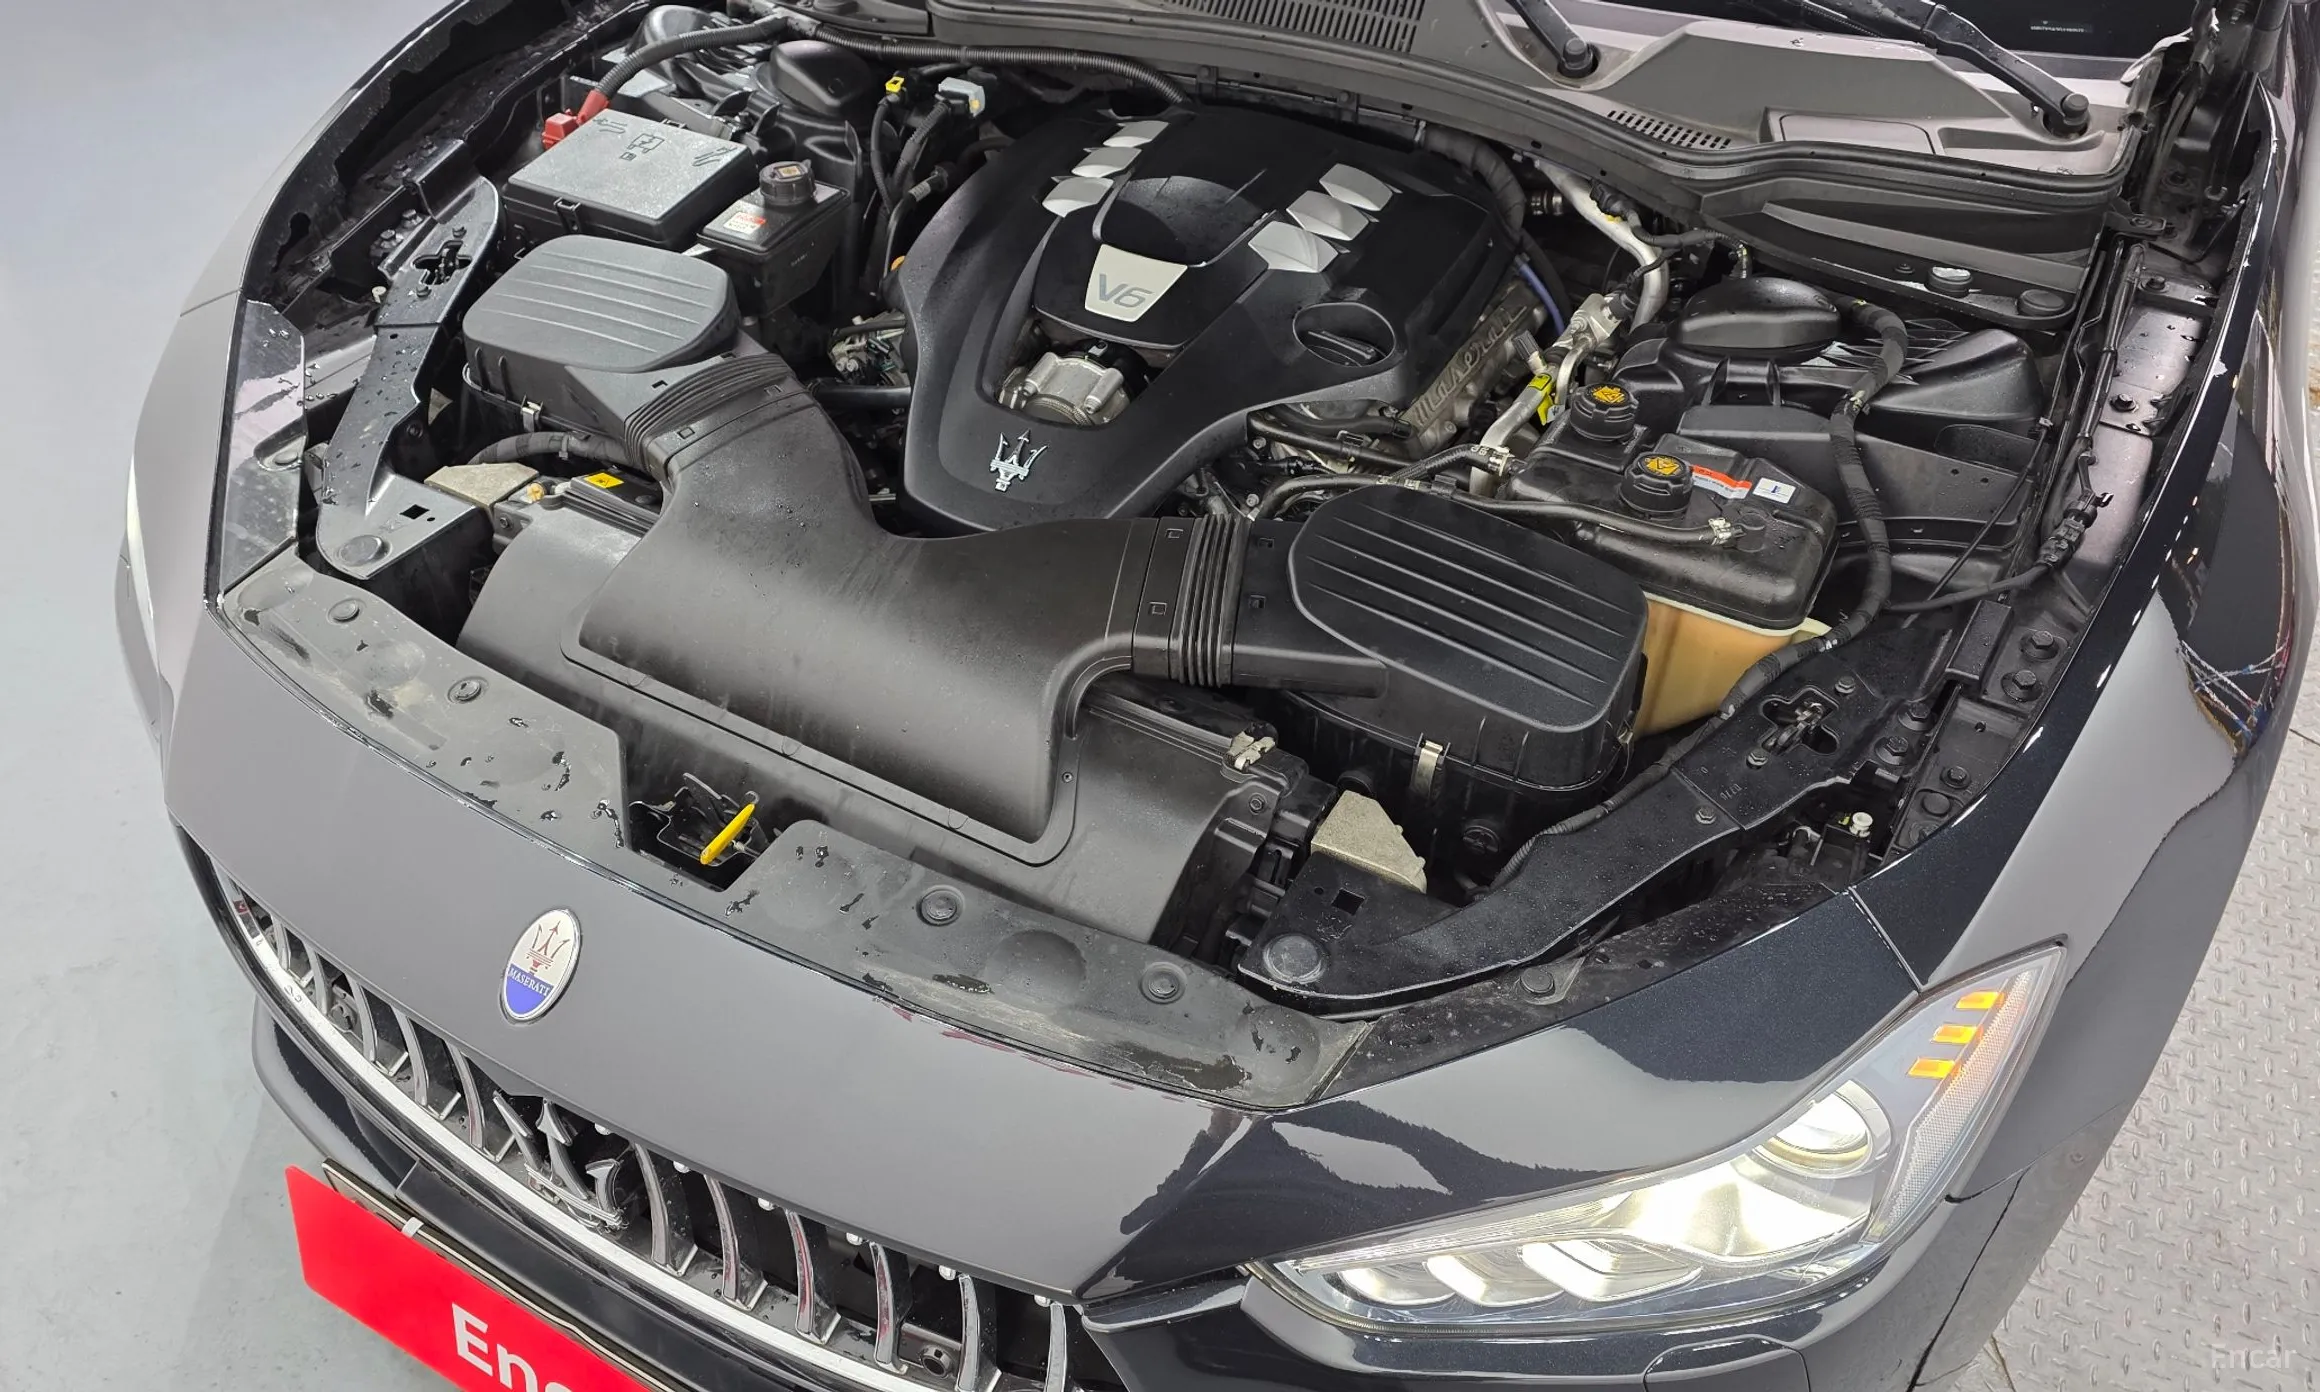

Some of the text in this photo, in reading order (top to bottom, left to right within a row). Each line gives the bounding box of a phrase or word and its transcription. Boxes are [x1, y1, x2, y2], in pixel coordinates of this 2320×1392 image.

[1099, 273, 1155, 308] V6
[507, 967, 551, 997] MASERATI
[452, 1303, 572, 1392] En
